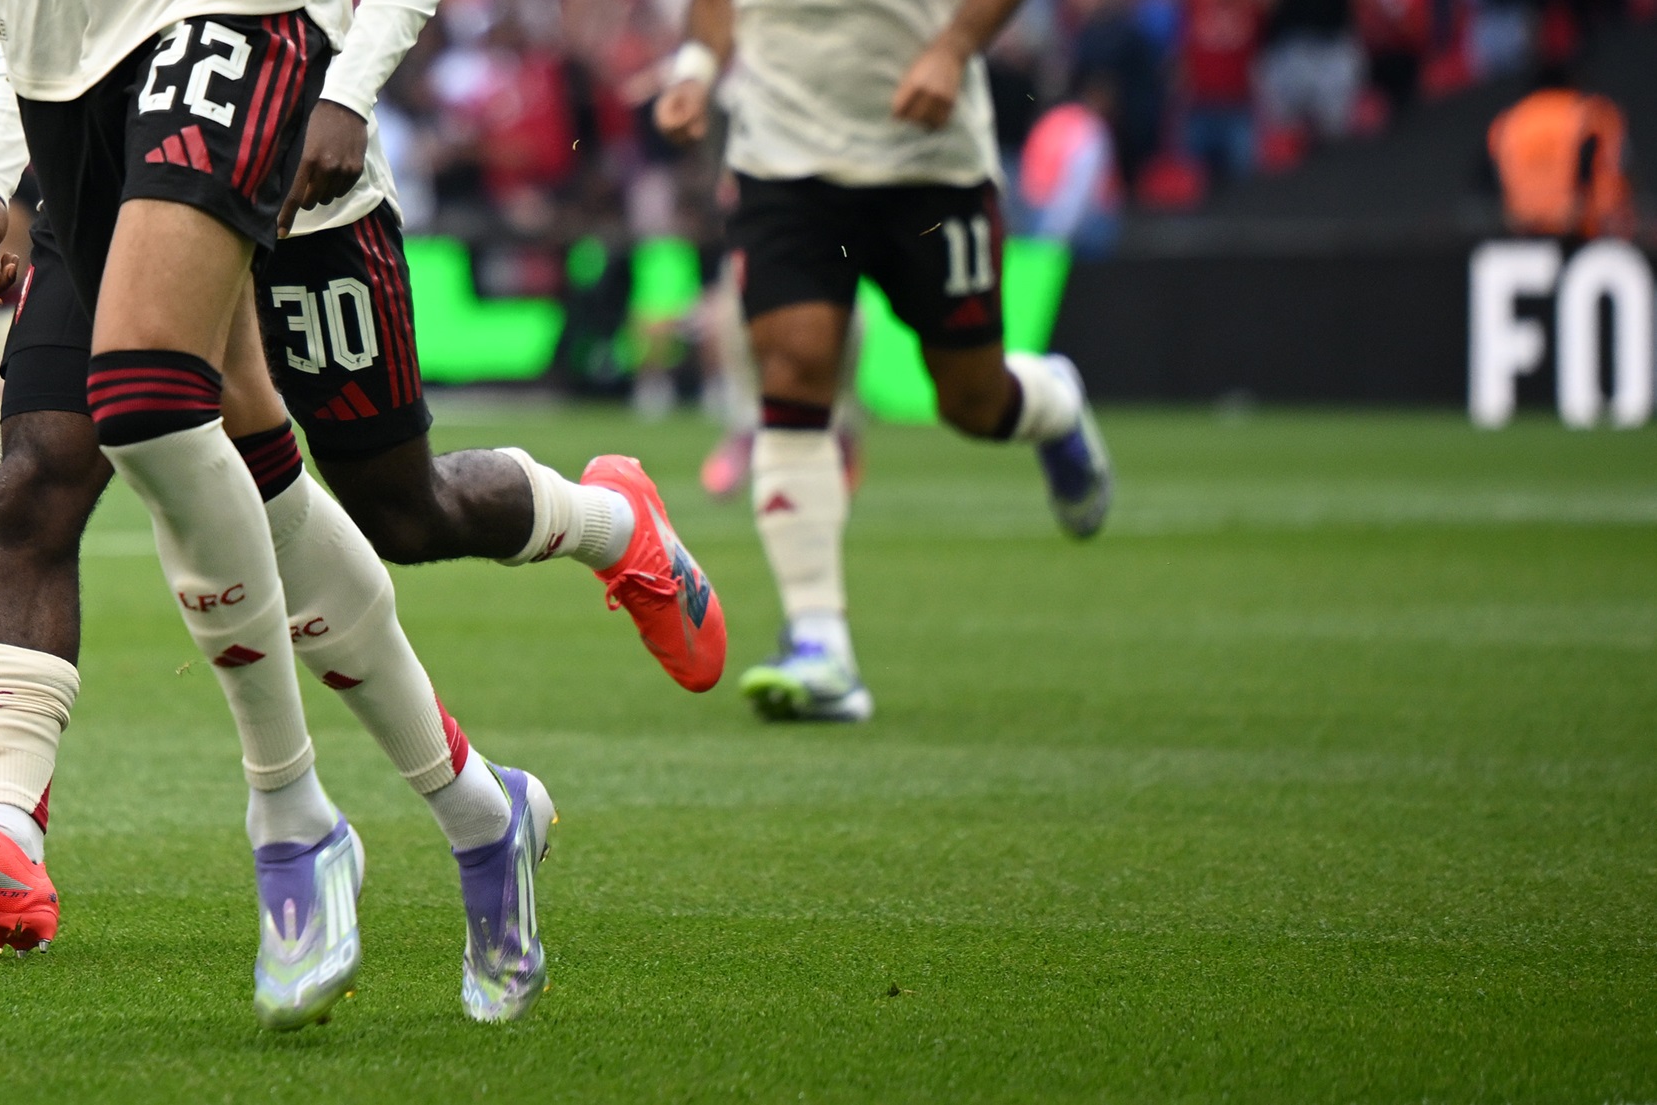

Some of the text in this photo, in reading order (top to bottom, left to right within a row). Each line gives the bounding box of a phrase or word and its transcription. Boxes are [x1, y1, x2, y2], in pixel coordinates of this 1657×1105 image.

[138, 20, 253, 128] 22
[943, 215, 995, 296] 11
[270, 277, 379, 374] 30
[178, 583, 245, 613] LFC
